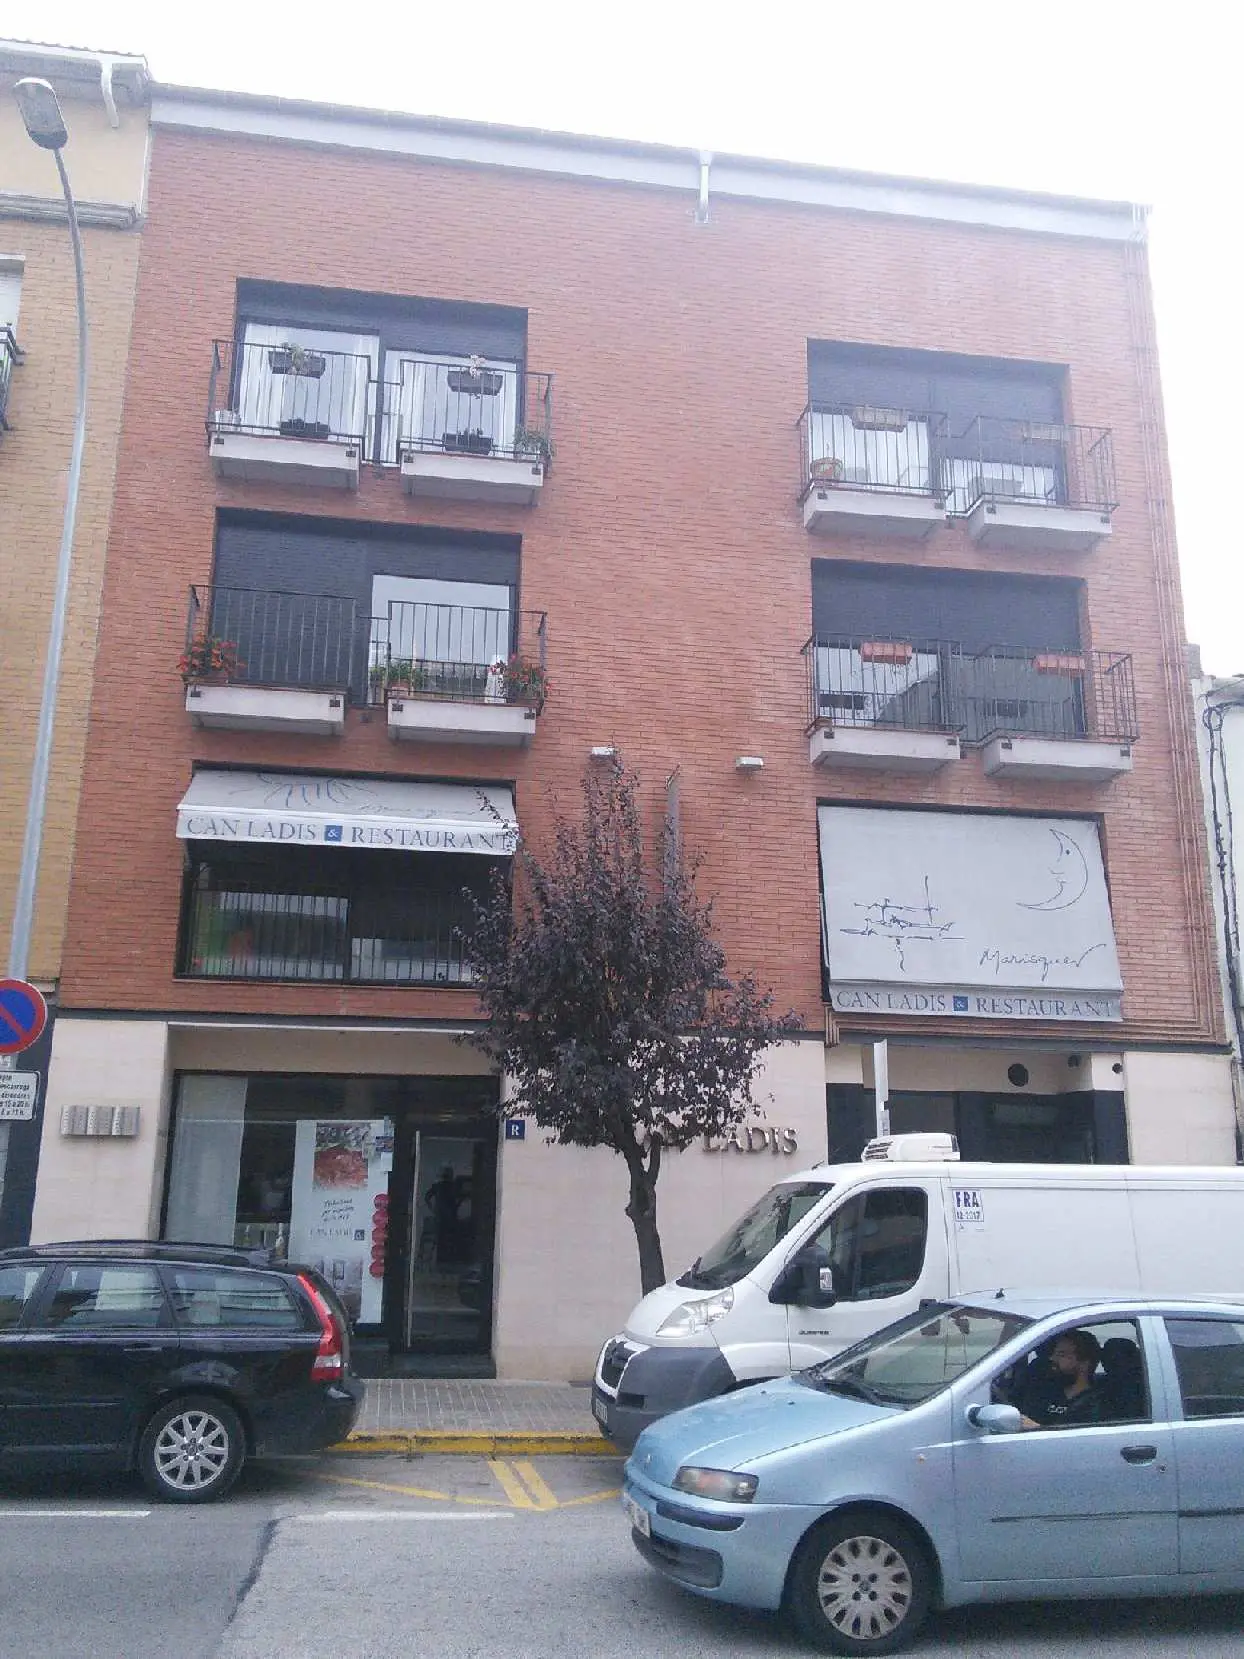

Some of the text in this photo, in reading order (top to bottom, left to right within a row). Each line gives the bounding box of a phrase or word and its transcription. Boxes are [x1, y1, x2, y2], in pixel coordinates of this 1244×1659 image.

[187, 817, 240, 836] CAN
[247, 820, 317, 840] LADIS
[351, 826, 509, 850] RESTAURANT
[836, 990, 881, 1009] CAN
[886, 993, 946, 1012] LADIS
[975, 997, 1114, 1018] RESTAURANT
[511, 1124, 520, 1136] R
[703, 1126, 798, 1154] LADIS
[955, 1191, 980, 1208] FRA
